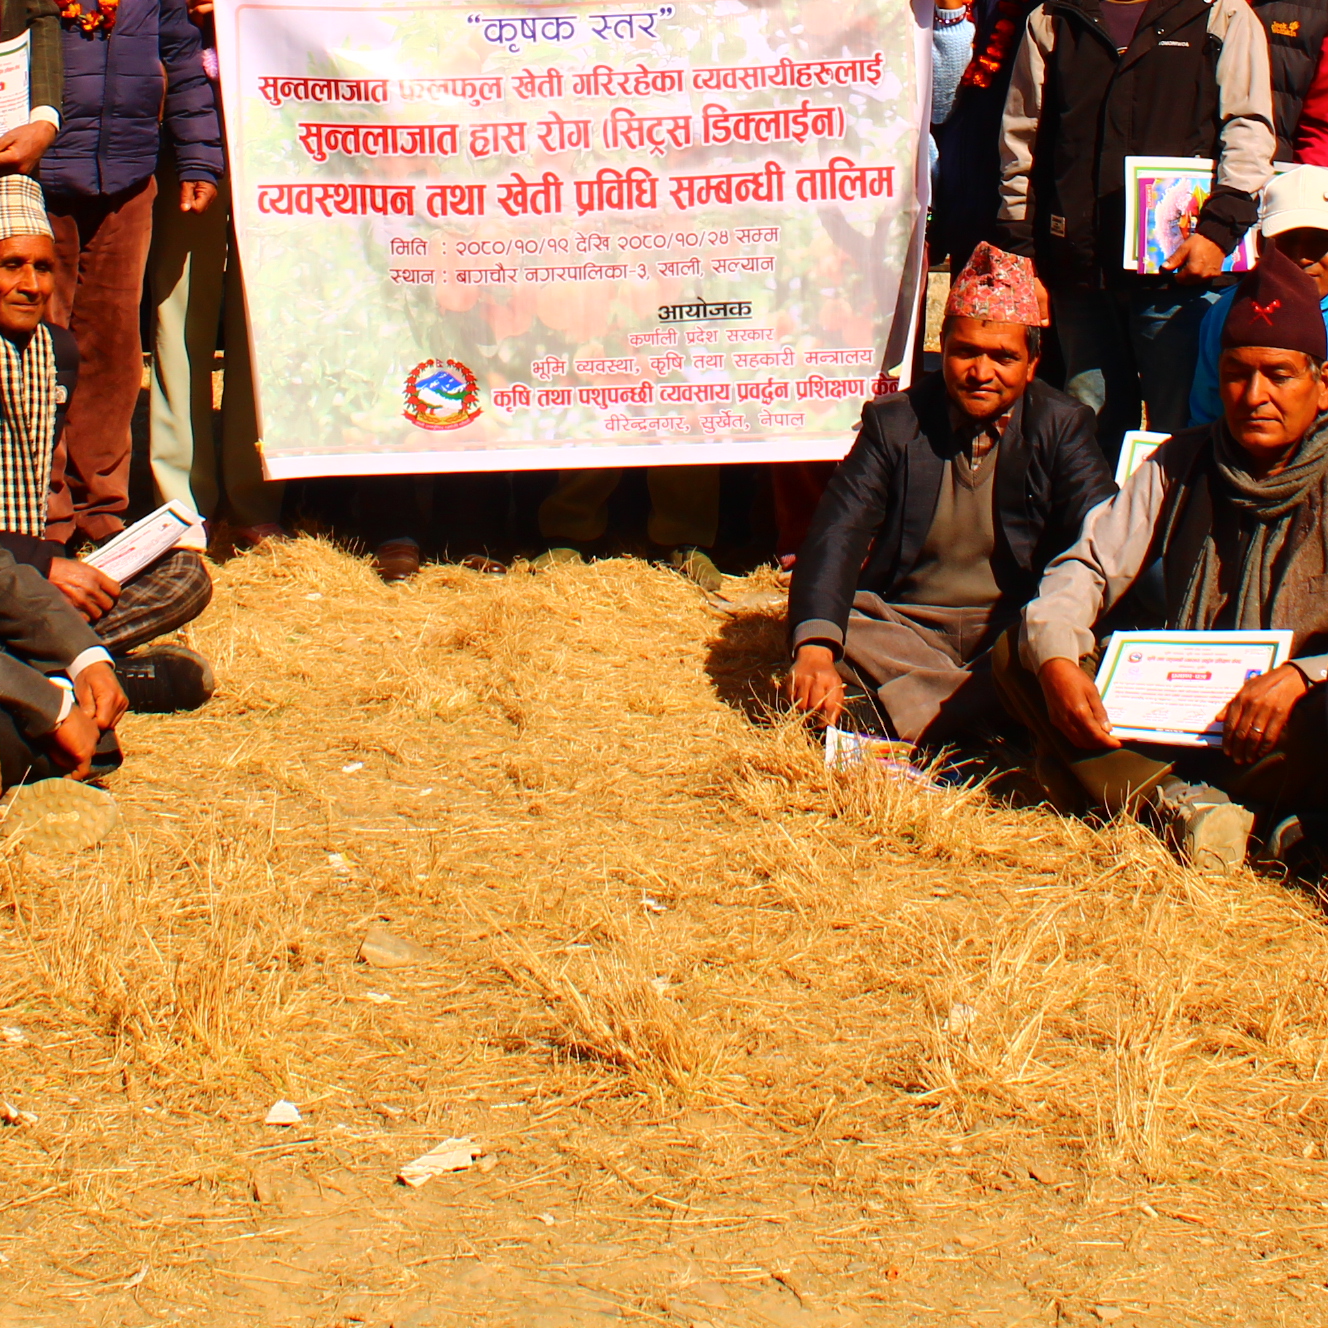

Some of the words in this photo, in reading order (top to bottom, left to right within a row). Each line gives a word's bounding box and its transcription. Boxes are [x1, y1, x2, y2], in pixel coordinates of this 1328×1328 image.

[467, 14, 577, 53] “कृषक
[588, 7, 673, 40] स्तर”
[258, 76, 390, 106] सुन्तलाजात
[511, 68, 564, 99] खेती
[573, 64, 684, 96] गरिरहेका
[298, 123, 459, 161] सुन्तलाजात
[537, 111, 591, 153] रोग
[602, 107, 692, 155] (सिट्रस
[702, 100, 844, 144] डिक्लाईन)
[257, 184, 416, 218] व्यवस्थापन
[426, 184, 487, 218] तथा
[497, 172, 564, 217] खेती
[574, 168, 659, 216] प्रविधि
[669, 161, 786, 210] सम्बन्धी
[795, 157, 895, 203] तालिम
[390, 237, 428, 256] मिति
[575, 232, 610, 253] देखि
[617, 230, 729, 250] २०८०/१०/२४
[735, 227, 780, 244] सम्म
[389, 268, 435, 284] स्थान
[455, 262, 519, 284] बागचौर
[711, 256, 775, 274] सल्यान
[658, 297, 752, 321] आयोजक
[629, 326, 677, 347] कर्णाली
[685, 327, 719, 345] प्रदेश
[726, 328, 774, 343] सरकार
[532, 356, 566, 380] भूमि
[575, 359, 640, 375] व्यवस्था,
[650, 352, 684, 375] कृषि
[693, 354, 724, 370] तथा
[734, 348, 796, 368] सहकारी
[805, 349, 874, 366] मन्त्रालय
[493, 384, 531, 413] कृषि
[537, 388, 572, 407] तथा
[578, 381, 655, 410] पशुपन्छी
[660, 383, 730, 404] व्यवसाय
[795, 375, 866, 400] प्रशिक्षण
[604, 412, 690, 433] वीरेन्द्रनगर,
[698, 410, 750, 434] सुर्खेत,
[758, 410, 805, 428] नेपाल
